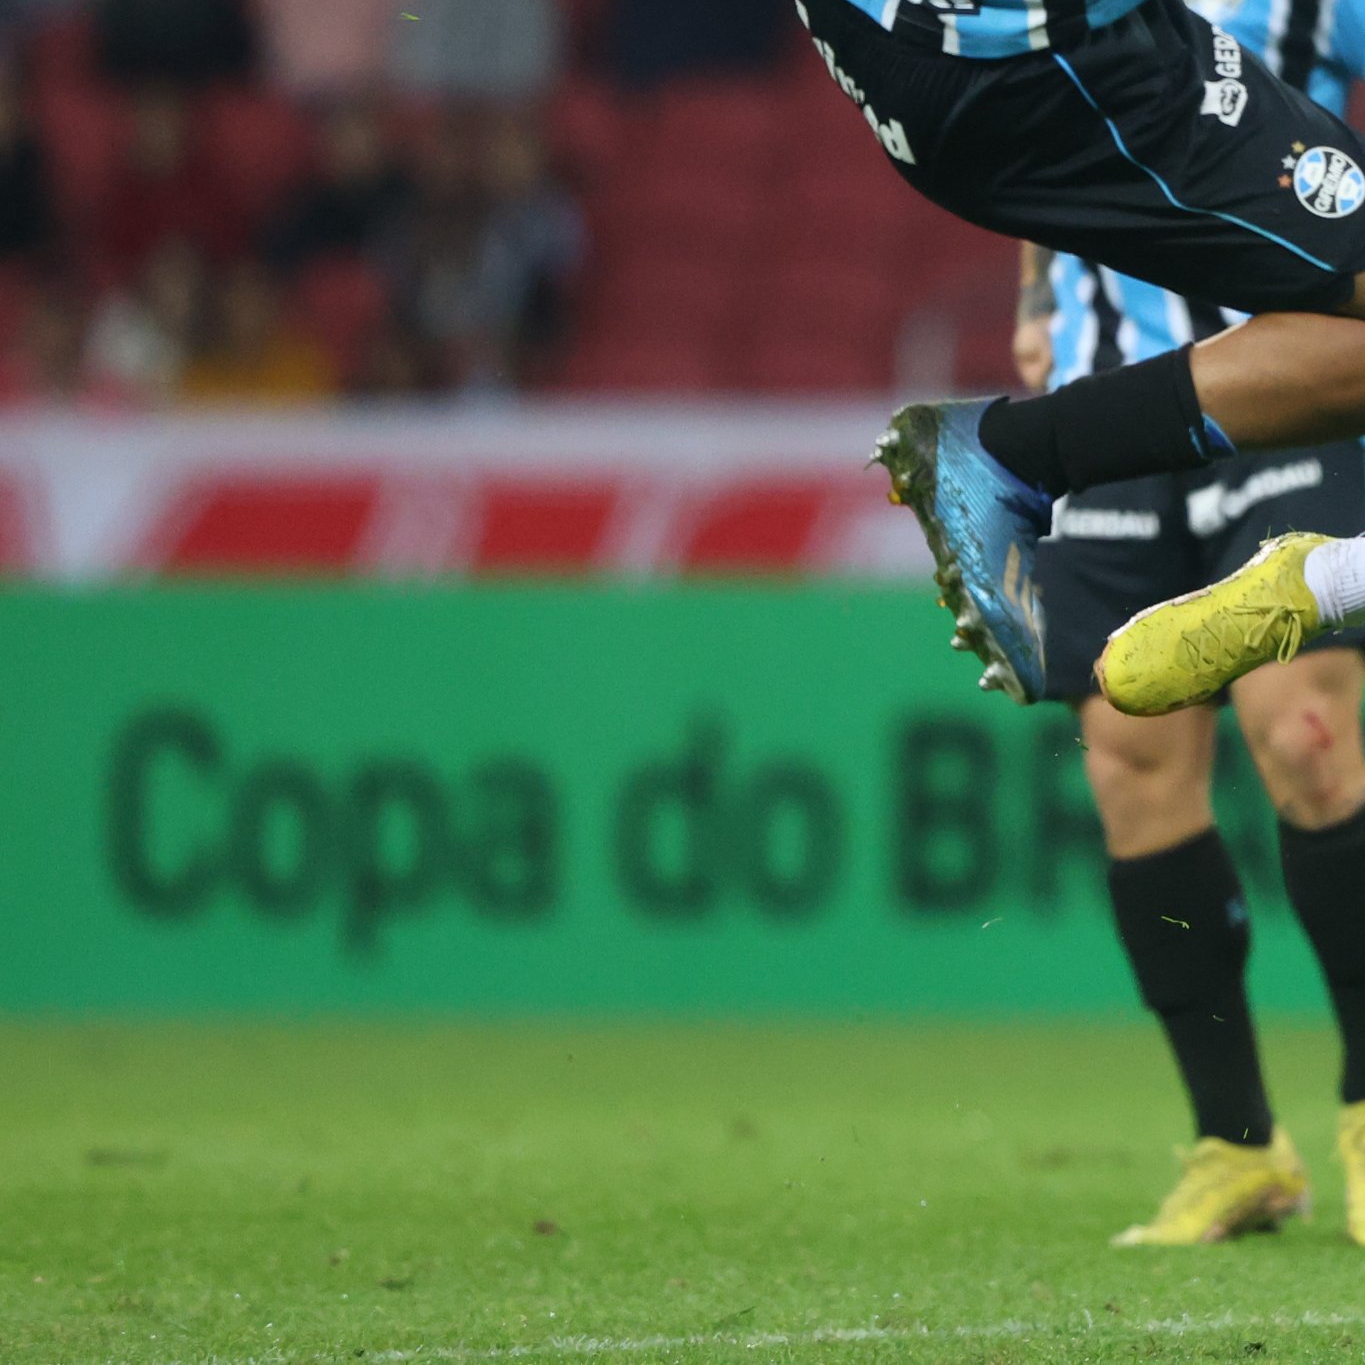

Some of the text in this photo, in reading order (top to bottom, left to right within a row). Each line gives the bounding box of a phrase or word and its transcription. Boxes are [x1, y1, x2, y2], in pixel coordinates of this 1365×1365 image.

[1212, 25, 1242, 78] GER
[108, 704, 558, 962] Copa
[618, 704, 840, 926] do
